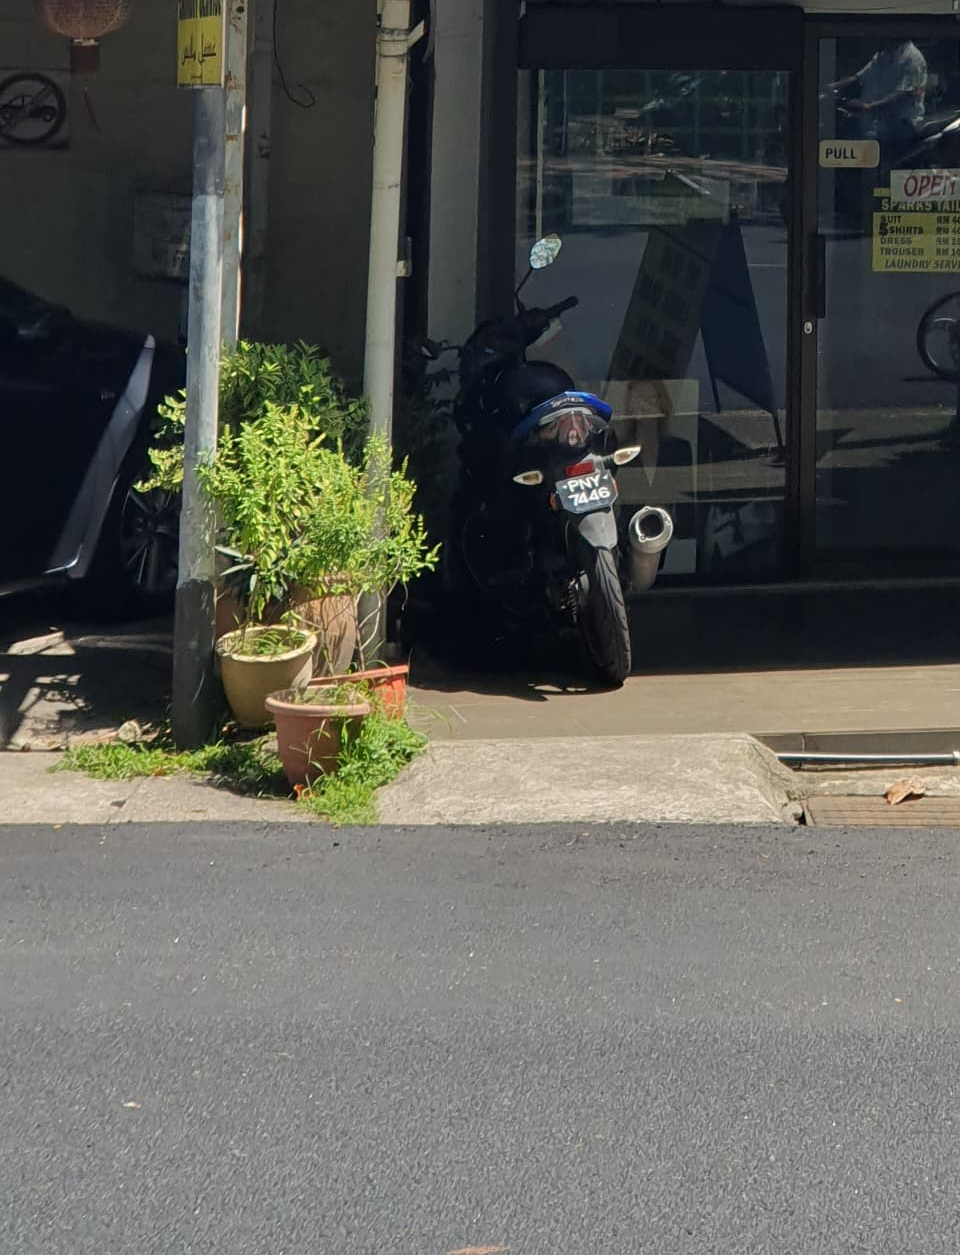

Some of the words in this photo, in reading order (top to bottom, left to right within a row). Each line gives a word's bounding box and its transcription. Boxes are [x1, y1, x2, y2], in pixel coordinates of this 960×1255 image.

[825, 147, 857, 160] PULL
[903, 174, 957, 197] OPEN
[880, 247, 925, 256] TROUSER
[567, 474, 601, 493] PNY
[568, 486, 611, 507] 7446
